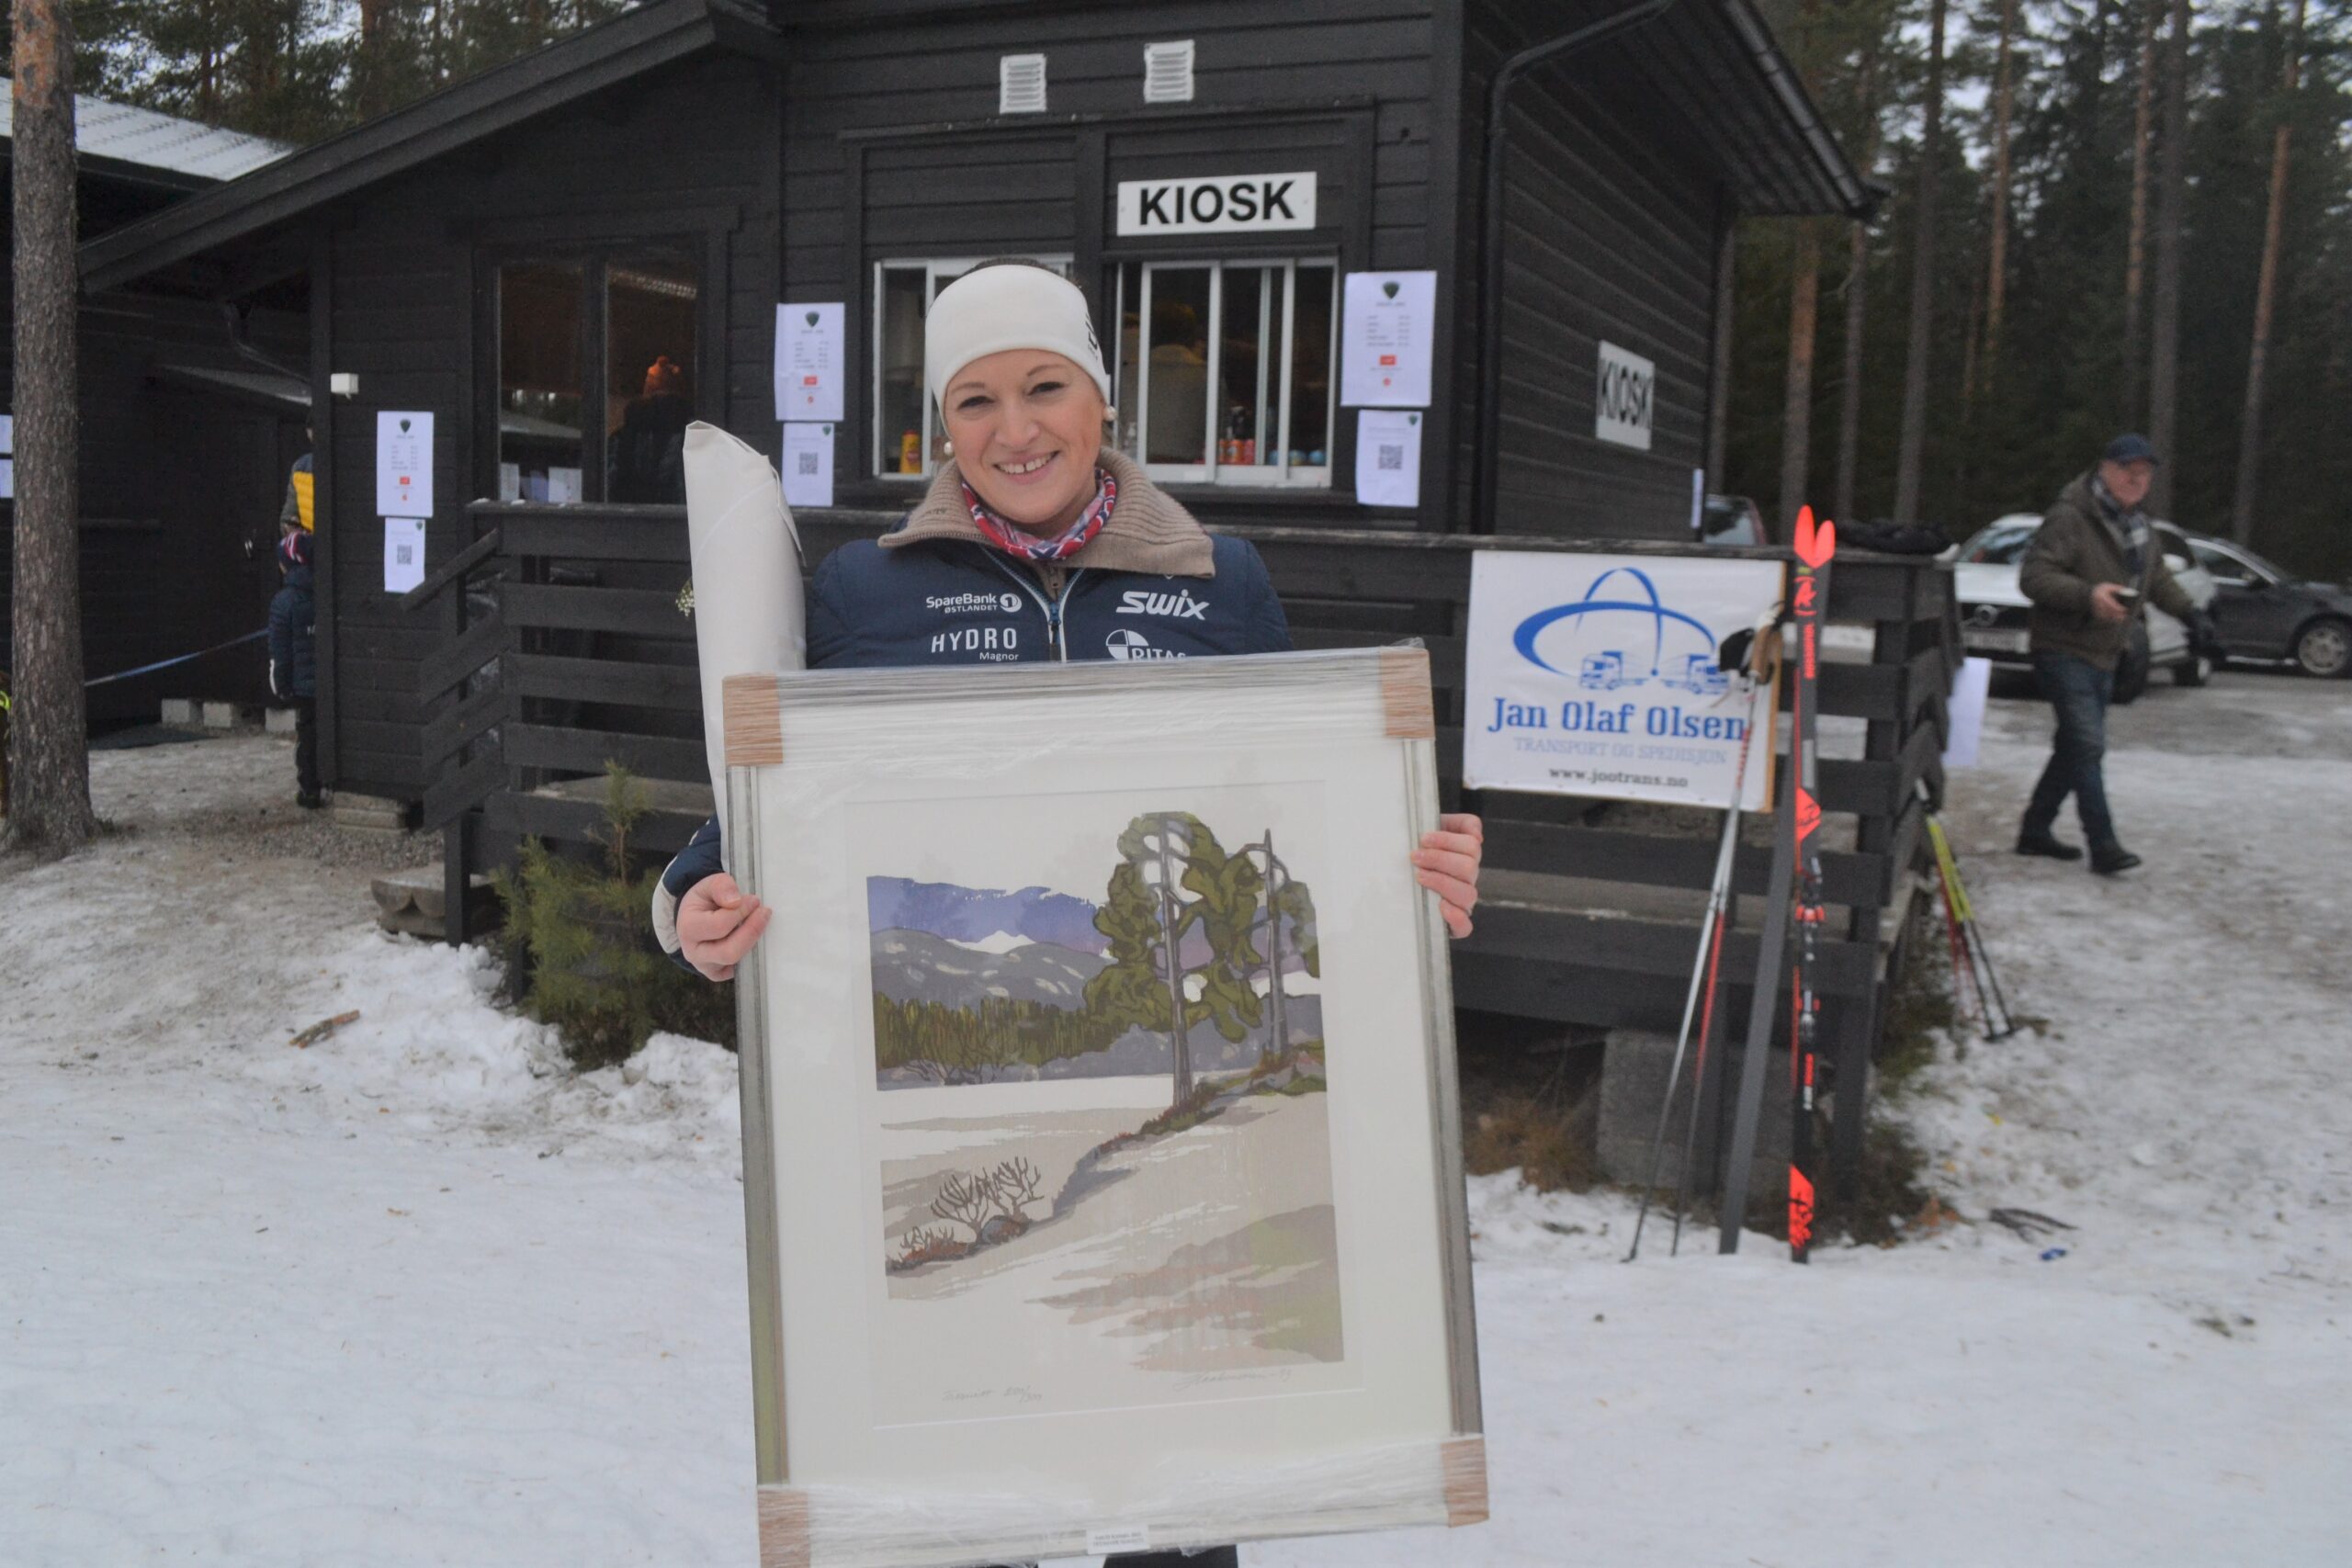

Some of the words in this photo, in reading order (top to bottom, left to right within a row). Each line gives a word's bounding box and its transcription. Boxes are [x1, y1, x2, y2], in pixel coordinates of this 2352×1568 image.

[1139, 180, 1296, 226] KIOSK
[1597, 357, 1653, 430] KIOSK
[925, 592, 997, 609] SpareBank
[944, 604, 998, 614] ØSTLANDET
[931, 627, 1017, 653] HYDRO
[979, 652, 1019, 661] Magnor
[1487, 697, 1548, 732] Jan
[1561, 701, 1635, 734] Olaf
[1647, 706, 1745, 740] Olsen
[1514, 738, 1609, 759] TRANSPORT
[1612, 743, 1634, 760] OG
[1637, 746, 1728, 765] SPEDISJON
[1549, 766, 1689, 788] www.jootrans.no
